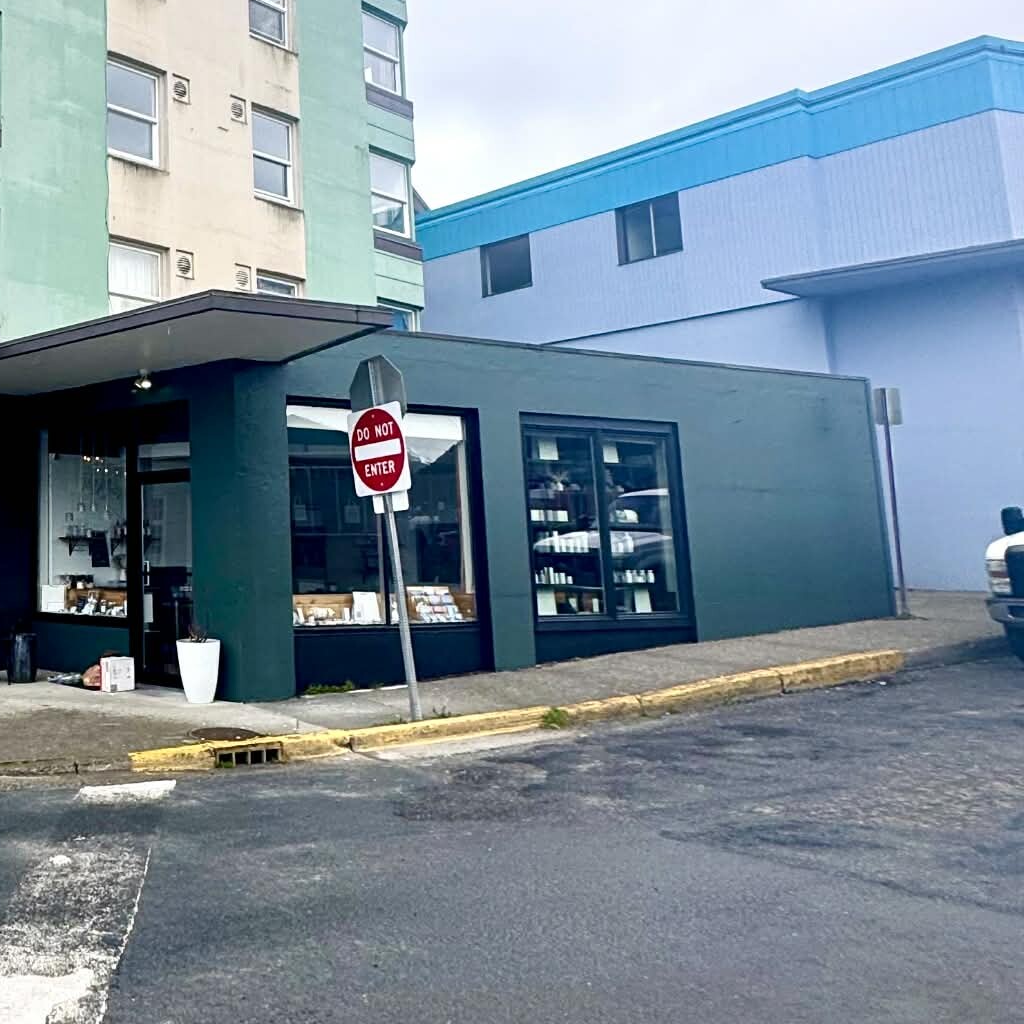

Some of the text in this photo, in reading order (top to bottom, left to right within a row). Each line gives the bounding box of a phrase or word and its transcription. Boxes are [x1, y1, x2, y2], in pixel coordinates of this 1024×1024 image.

[356, 421, 394, 442] DO NOT
[364, 460, 396, 478] ENTER
